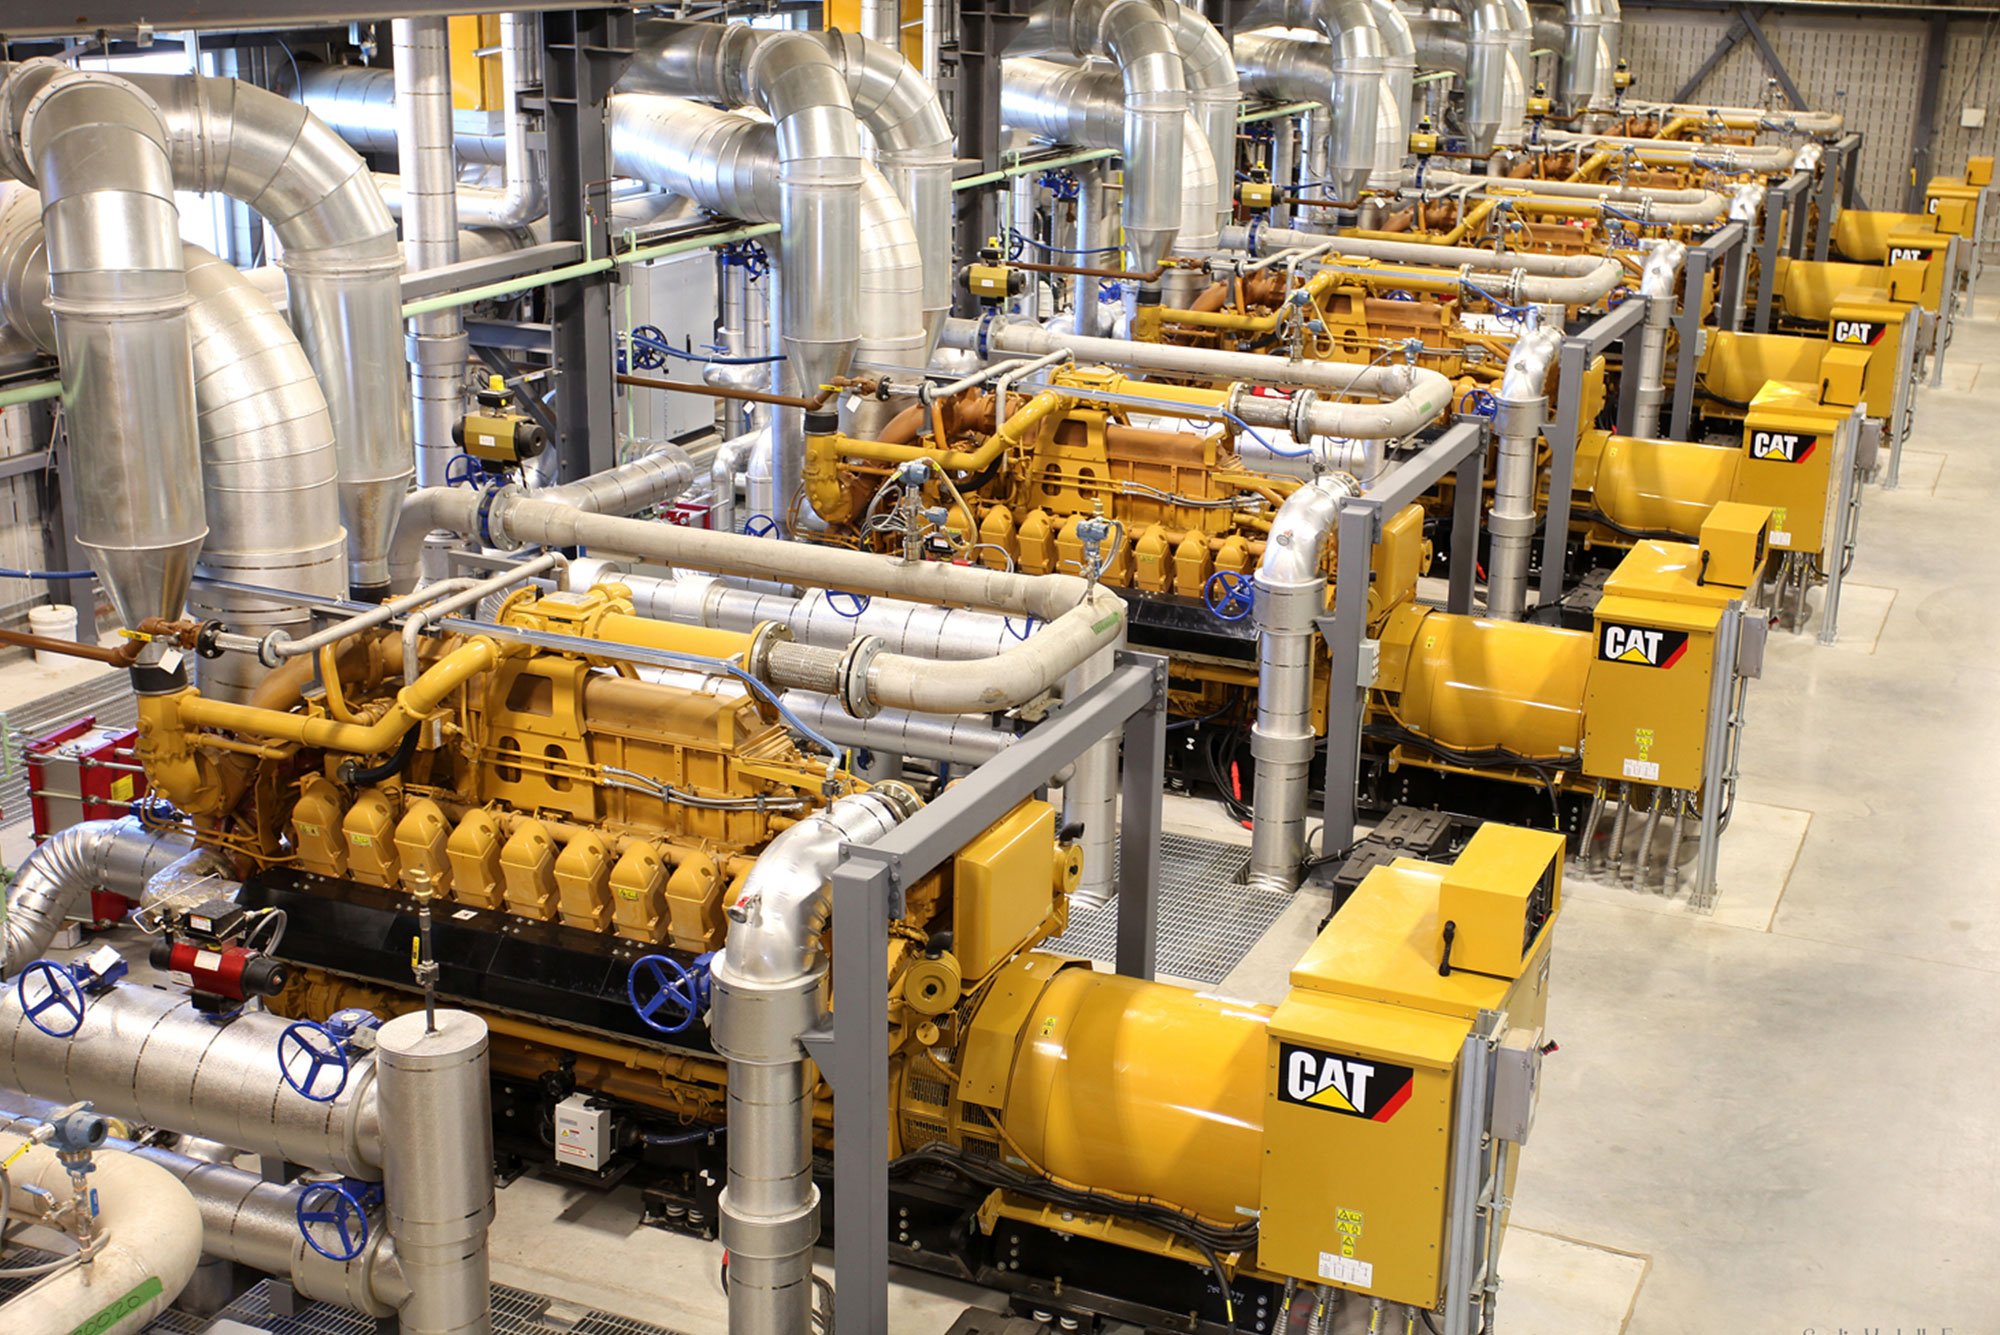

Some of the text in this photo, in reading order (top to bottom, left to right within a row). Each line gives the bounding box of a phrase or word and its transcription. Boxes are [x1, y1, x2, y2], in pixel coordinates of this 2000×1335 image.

[1835, 321, 1872, 344] CAT
[1754, 432, 1798, 461] CAT
[1605, 626, 1664, 665] CAT
[1287, 1051, 1375, 1114] CAT
[74, 1295, 141, 1335] 0020
